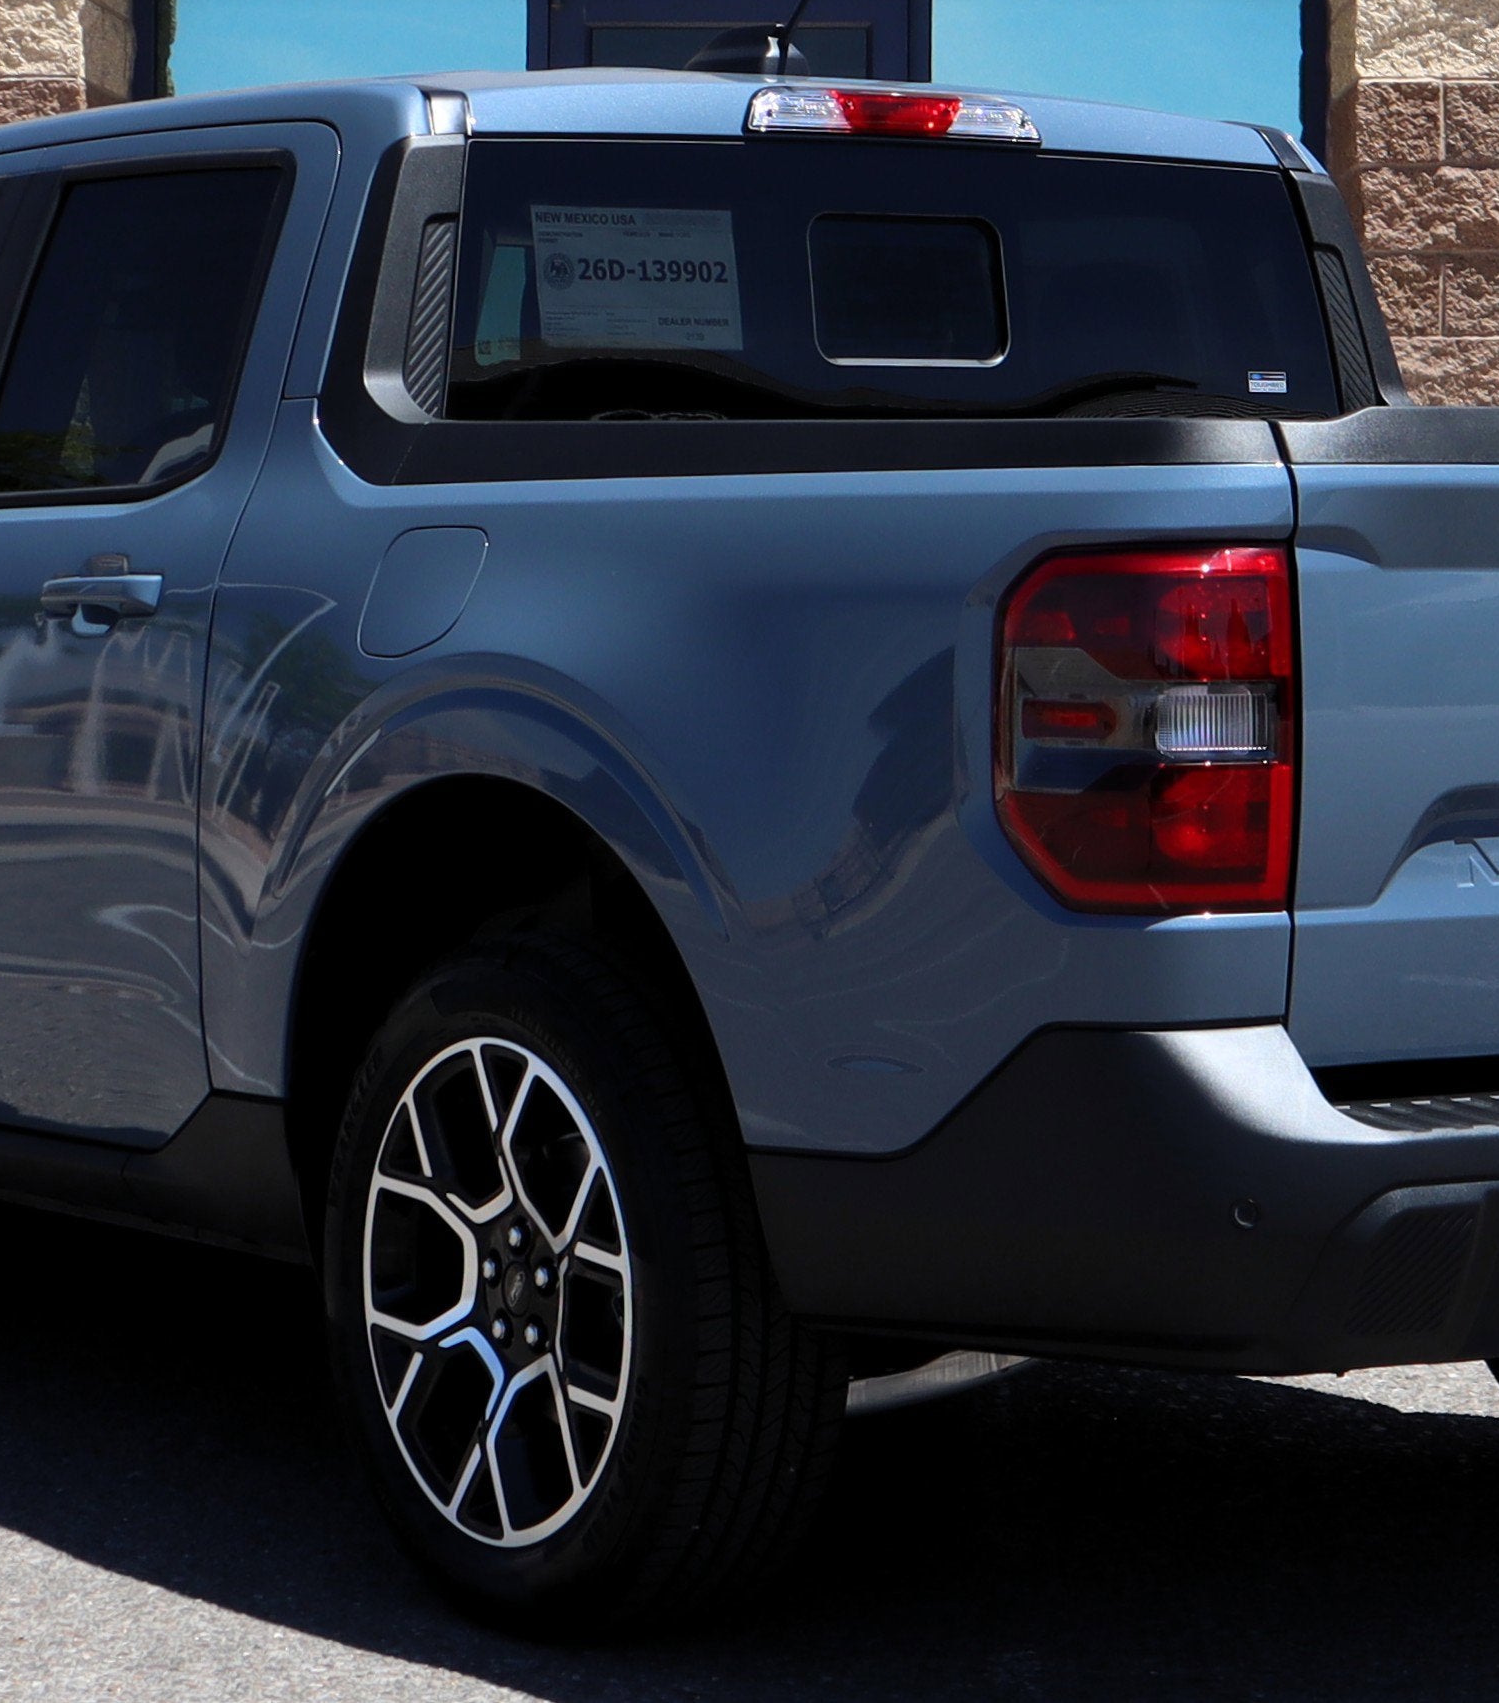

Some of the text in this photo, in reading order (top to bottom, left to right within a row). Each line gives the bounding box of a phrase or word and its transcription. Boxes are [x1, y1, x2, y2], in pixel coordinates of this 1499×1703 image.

[535, 211, 636, 226] NEW MEXICO USA
[577, 258, 729, 284] 26D-139902
[658, 317, 692, 328] DEALER
[693, 317, 730, 328] NUMBER
